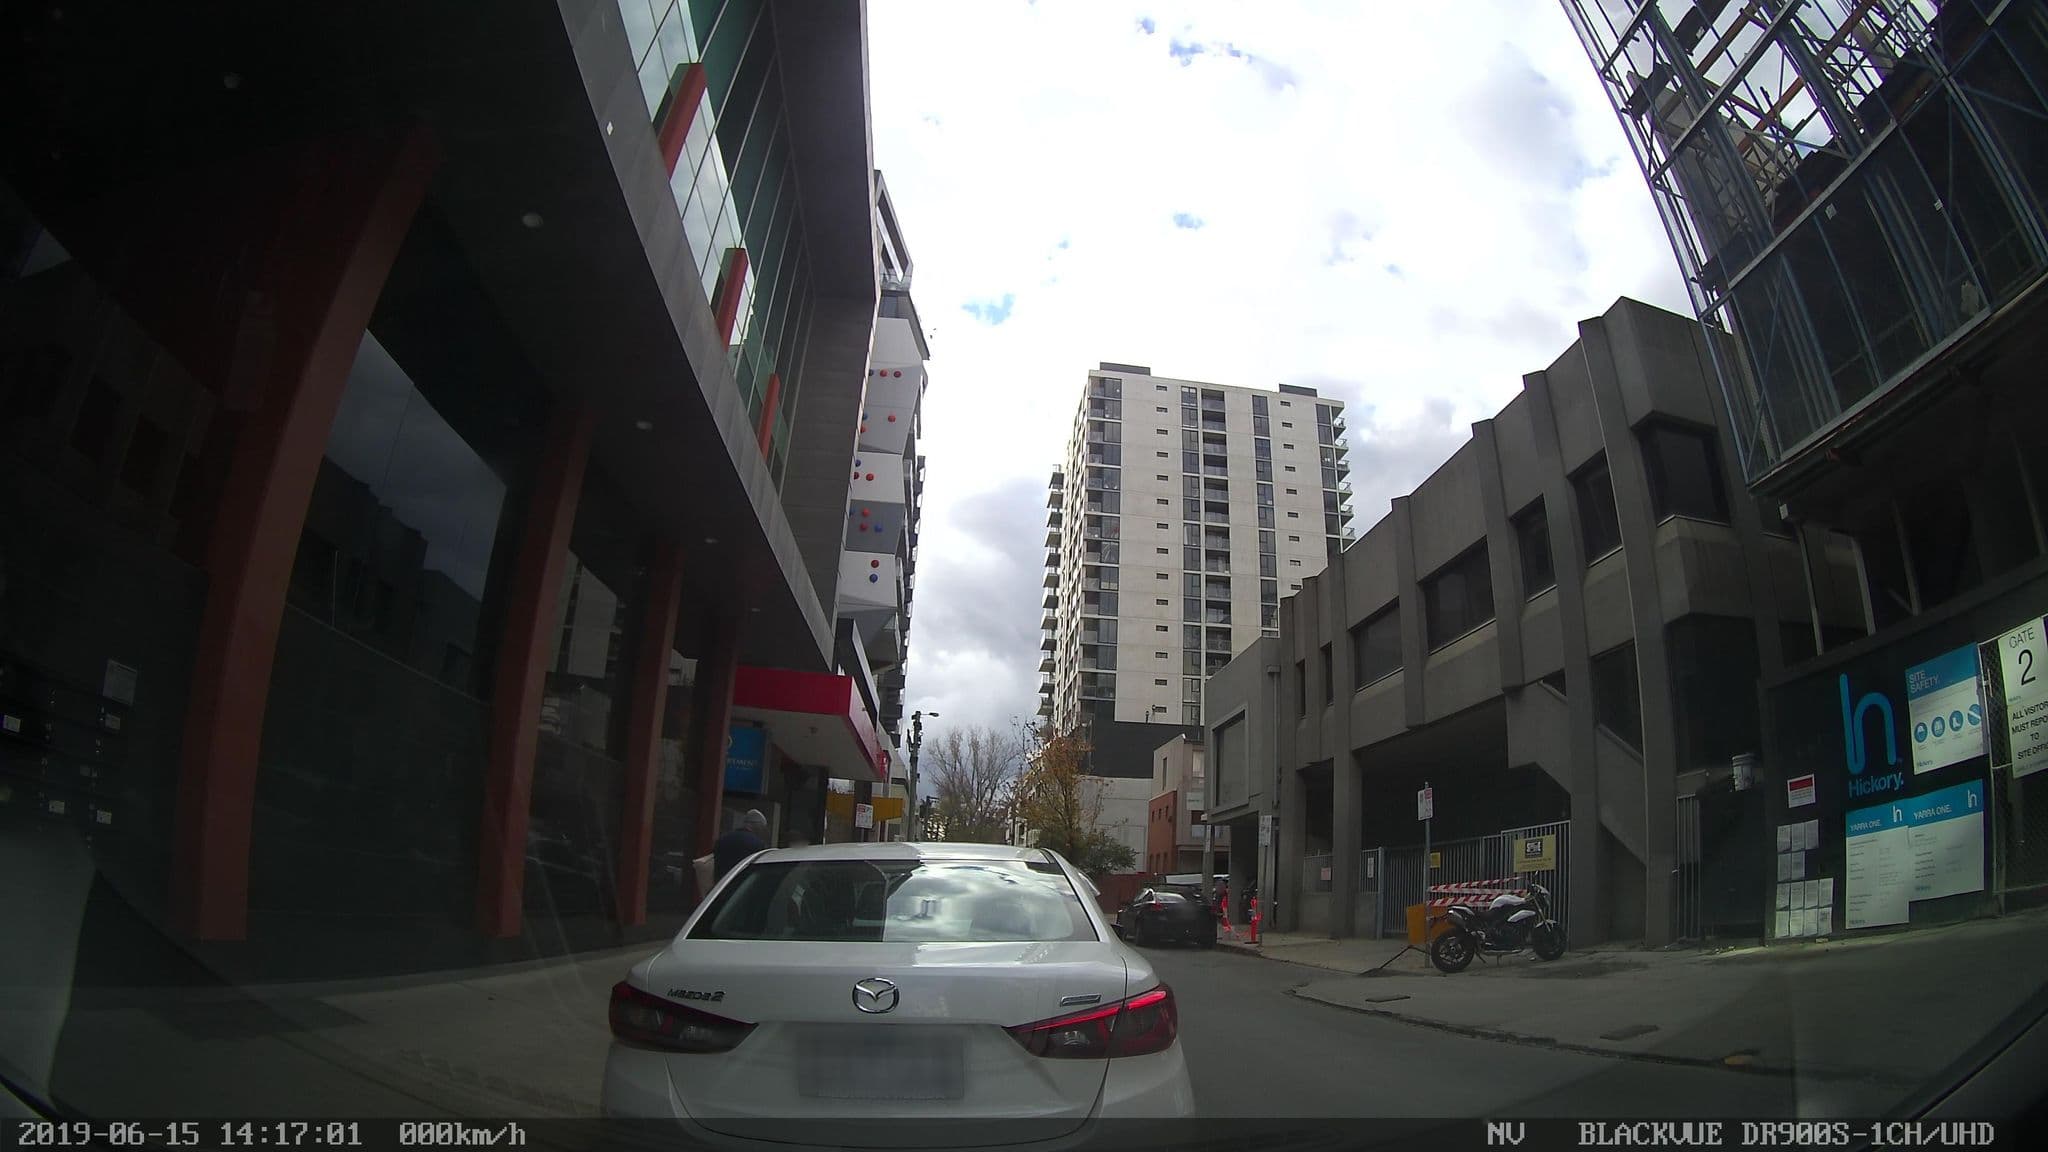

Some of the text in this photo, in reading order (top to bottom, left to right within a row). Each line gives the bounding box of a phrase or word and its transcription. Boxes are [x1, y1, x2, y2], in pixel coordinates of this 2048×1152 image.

[2009, 627, 2035, 649] GATE
[2018, 649, 2036, 685] 2
[1909, 671, 1925, 684] SITE
[2012, 710, 2024, 721] ALL
[2012, 722, 2029, 734] MUST
[2030, 731, 2040, 741] TO
[2018, 748, 2032, 760] SITE
[1913, 808, 1936, 821] YARRA
